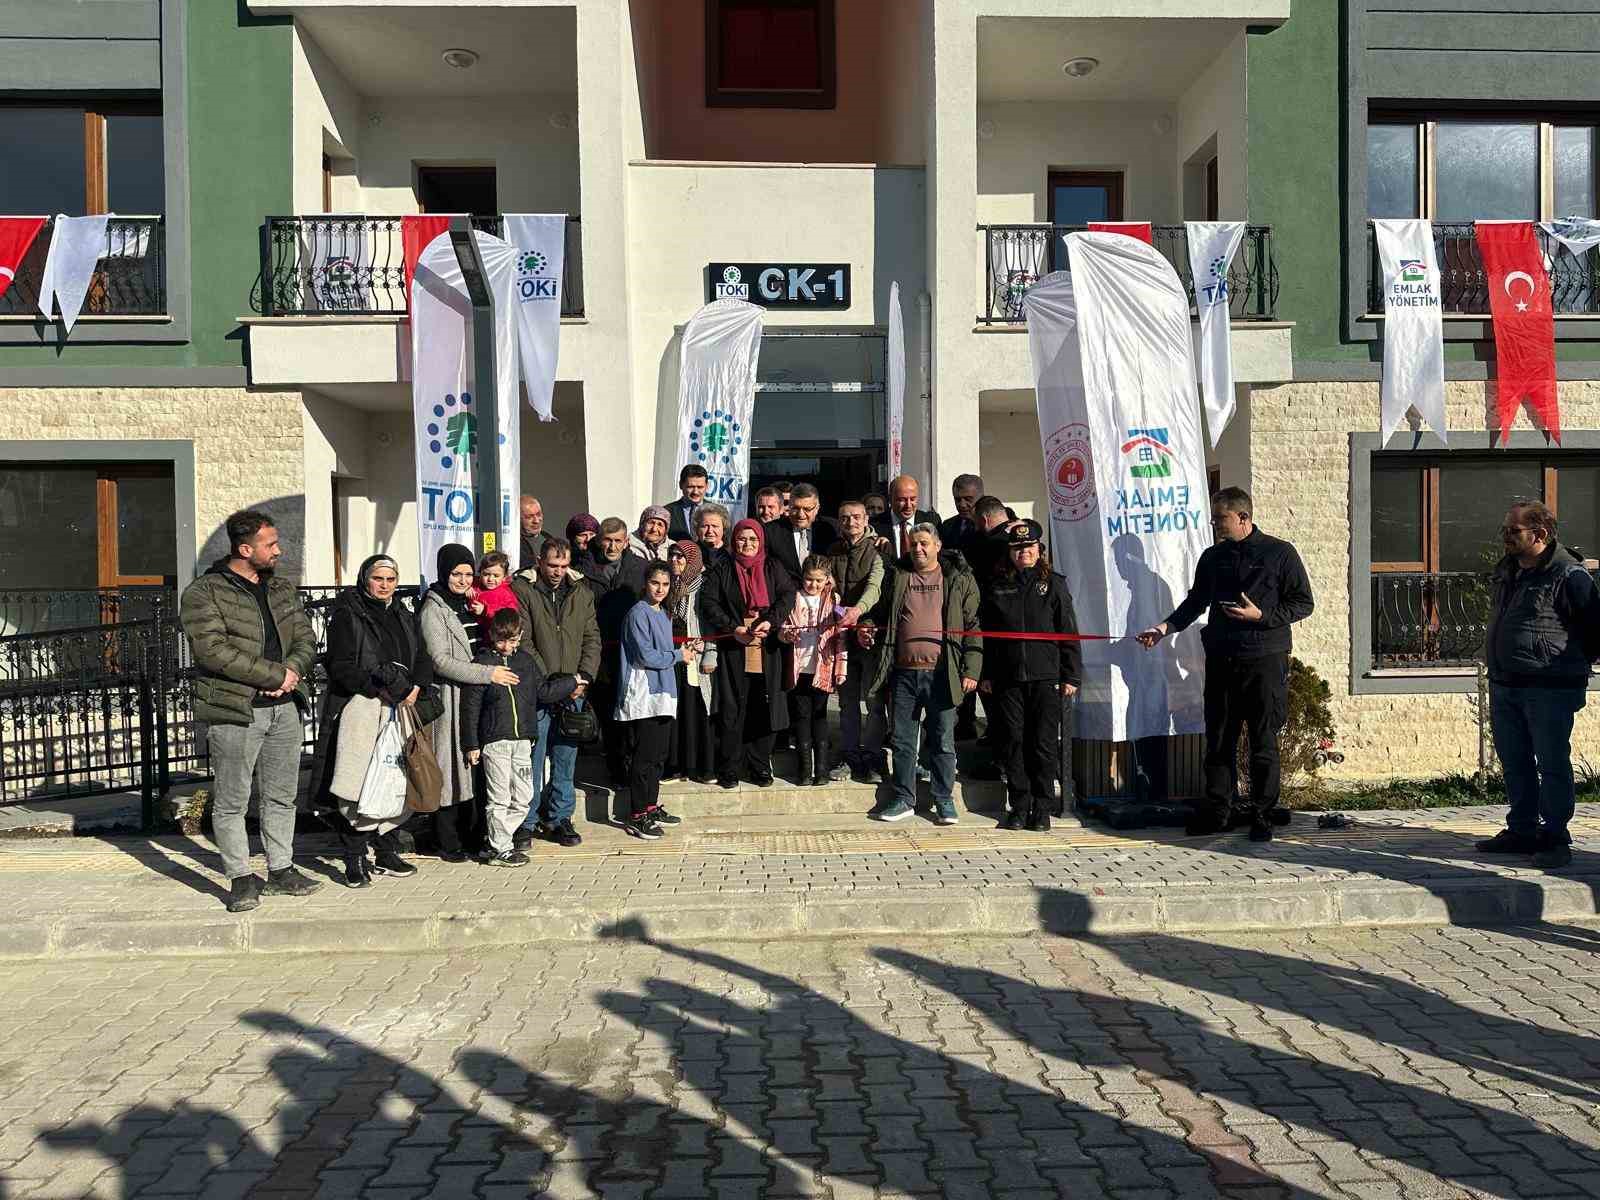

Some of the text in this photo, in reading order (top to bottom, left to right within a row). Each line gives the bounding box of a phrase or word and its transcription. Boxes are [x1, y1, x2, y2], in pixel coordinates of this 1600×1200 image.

[758, 267, 844, 300] CK-1
[1393, 284, 1432, 294] EMLAK
[1388, 294, 1439, 307] YÖNETİM
